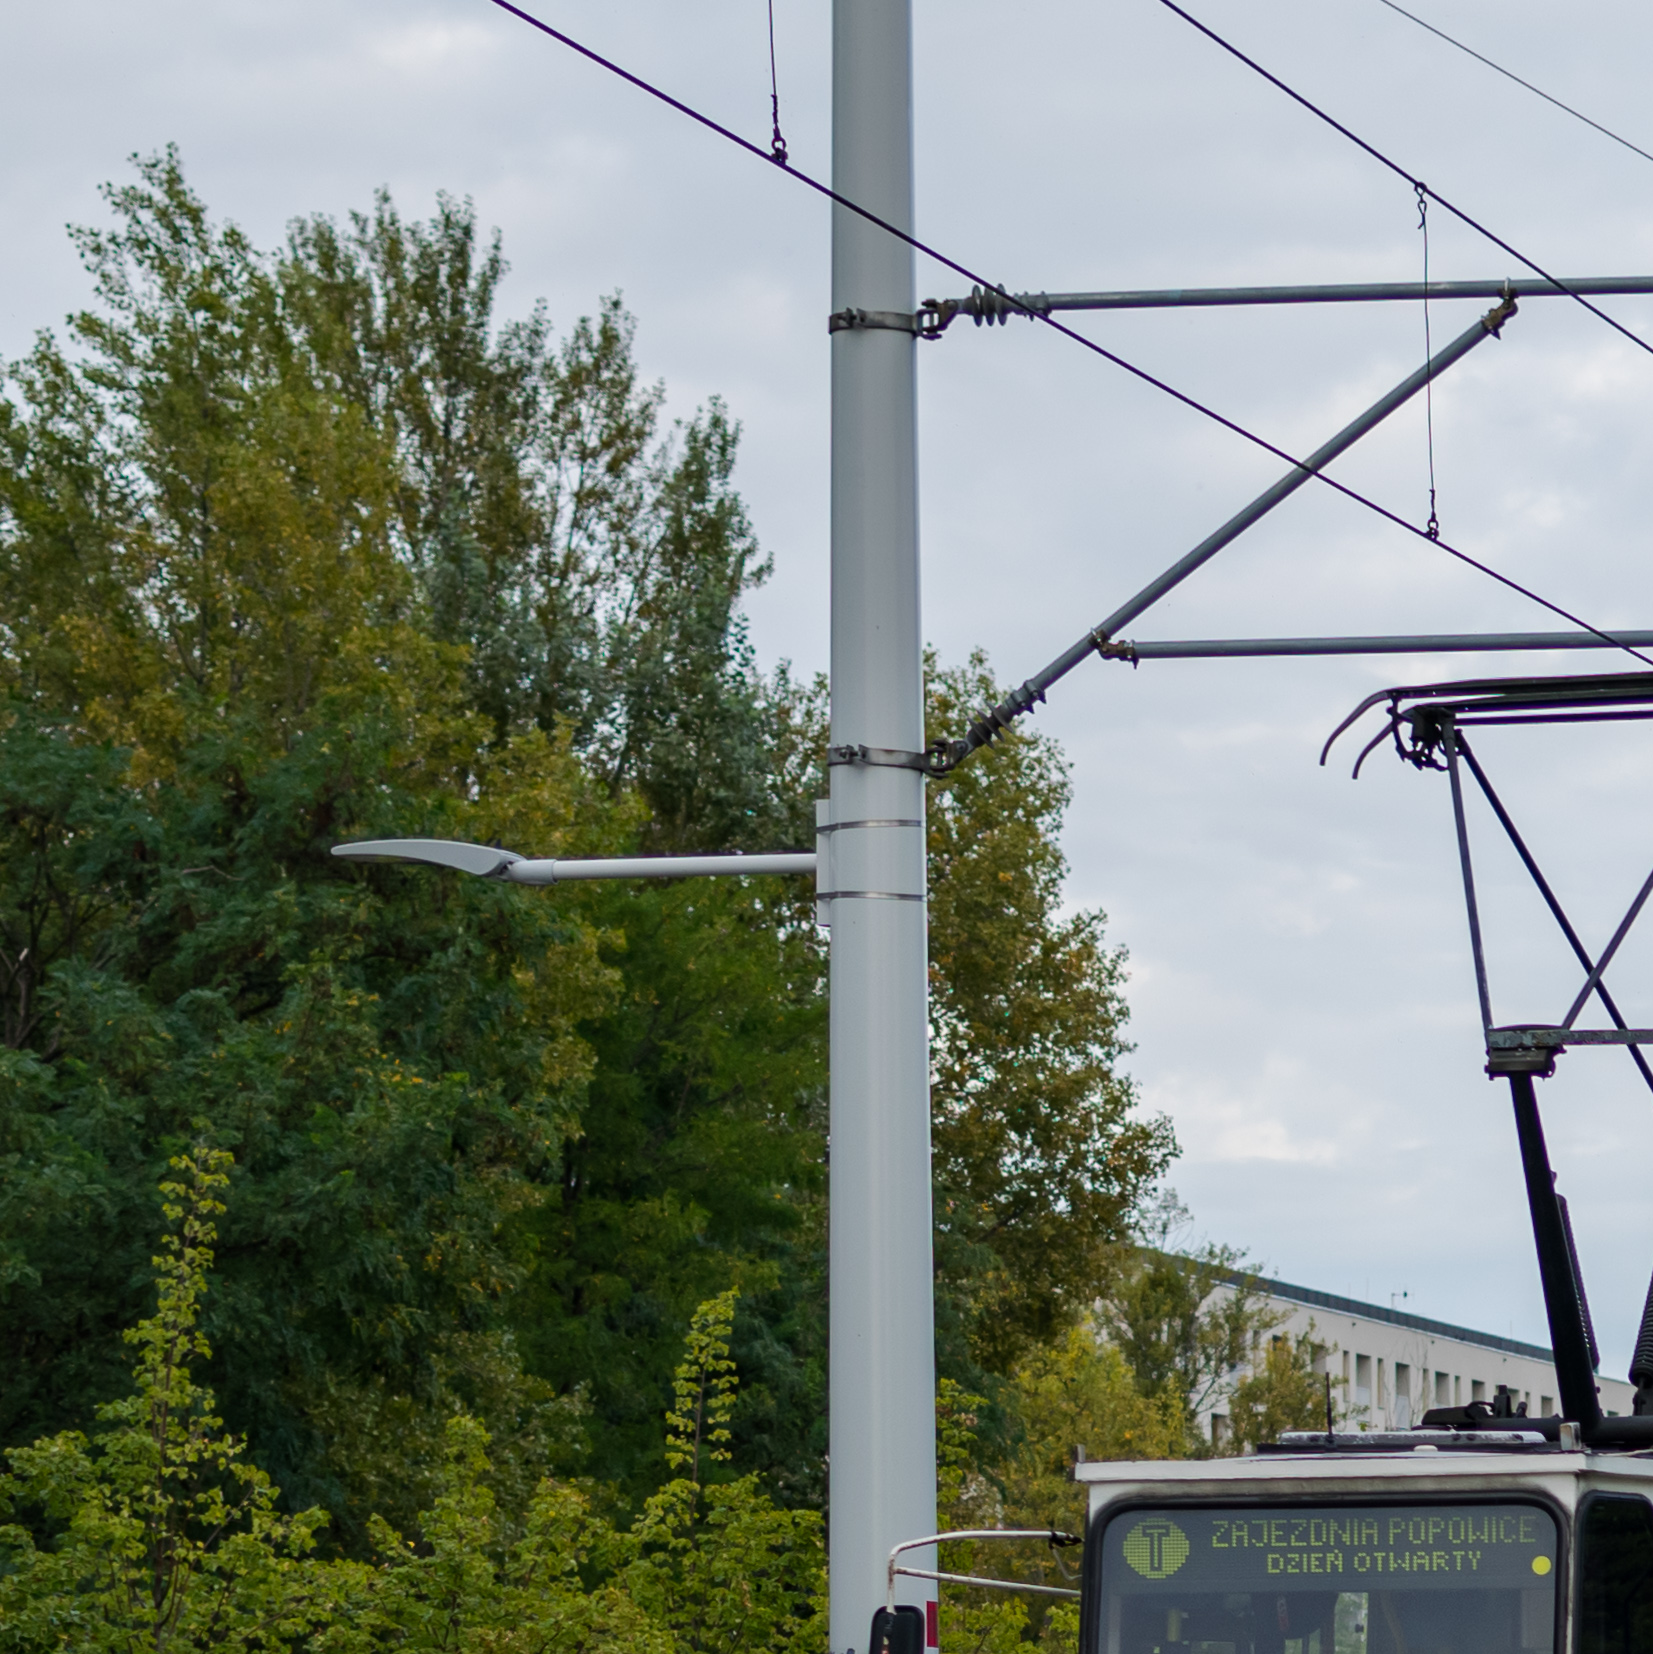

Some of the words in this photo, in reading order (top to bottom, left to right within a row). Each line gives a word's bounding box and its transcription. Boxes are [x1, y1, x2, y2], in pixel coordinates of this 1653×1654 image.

[1211, 1518, 1378, 1548] ZAJEZDNIA
[1388, 1515, 1537, 1546] POPOWICE
[1266, 1549, 1344, 1574] DZIEŃ
[1353, 1550, 1481, 1573] OTWARTY
